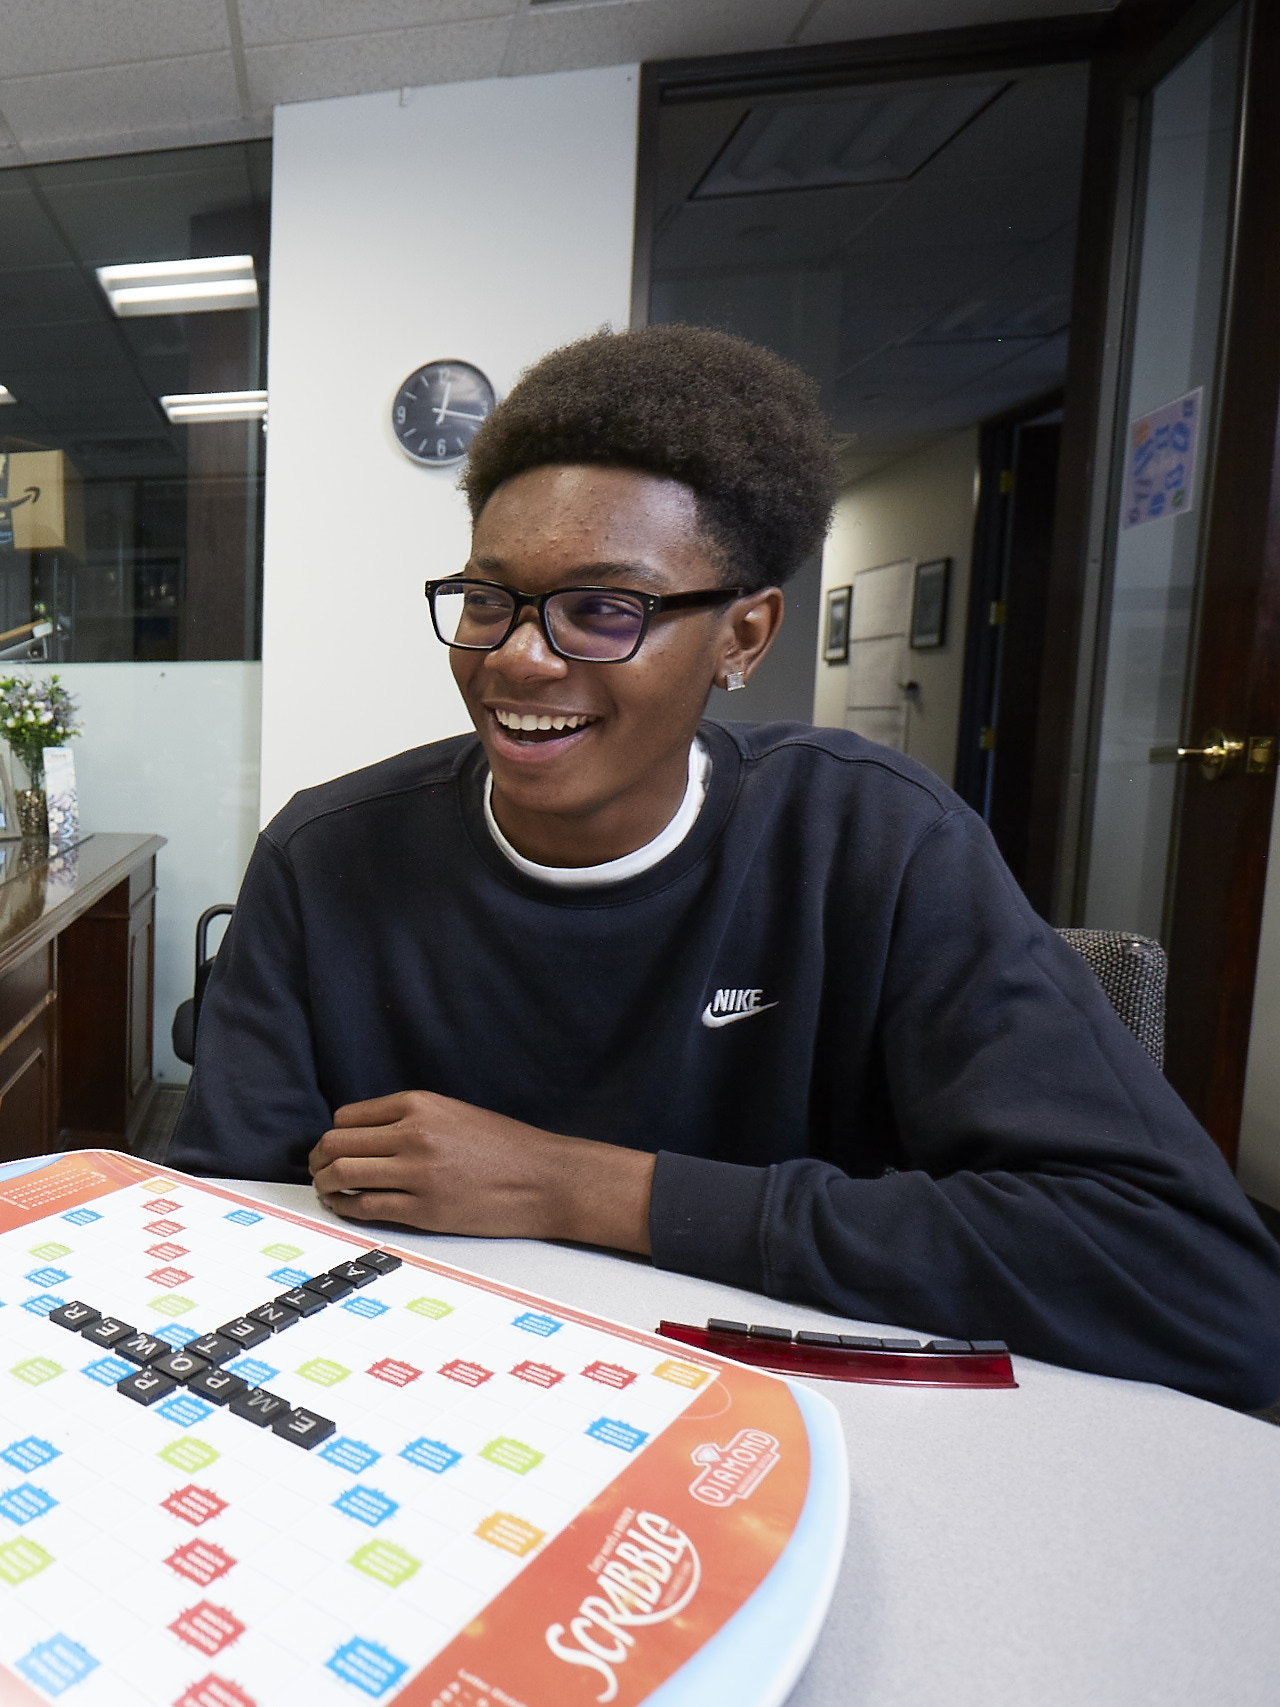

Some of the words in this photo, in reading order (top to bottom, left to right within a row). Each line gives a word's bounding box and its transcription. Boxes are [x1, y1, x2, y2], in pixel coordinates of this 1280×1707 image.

[397, 405, 406, 424] 9
[436, 438, 447, 456] 6
[713, 988, 764, 1012] NIKE
[698, 1432, 771, 1501] DIAMOND
